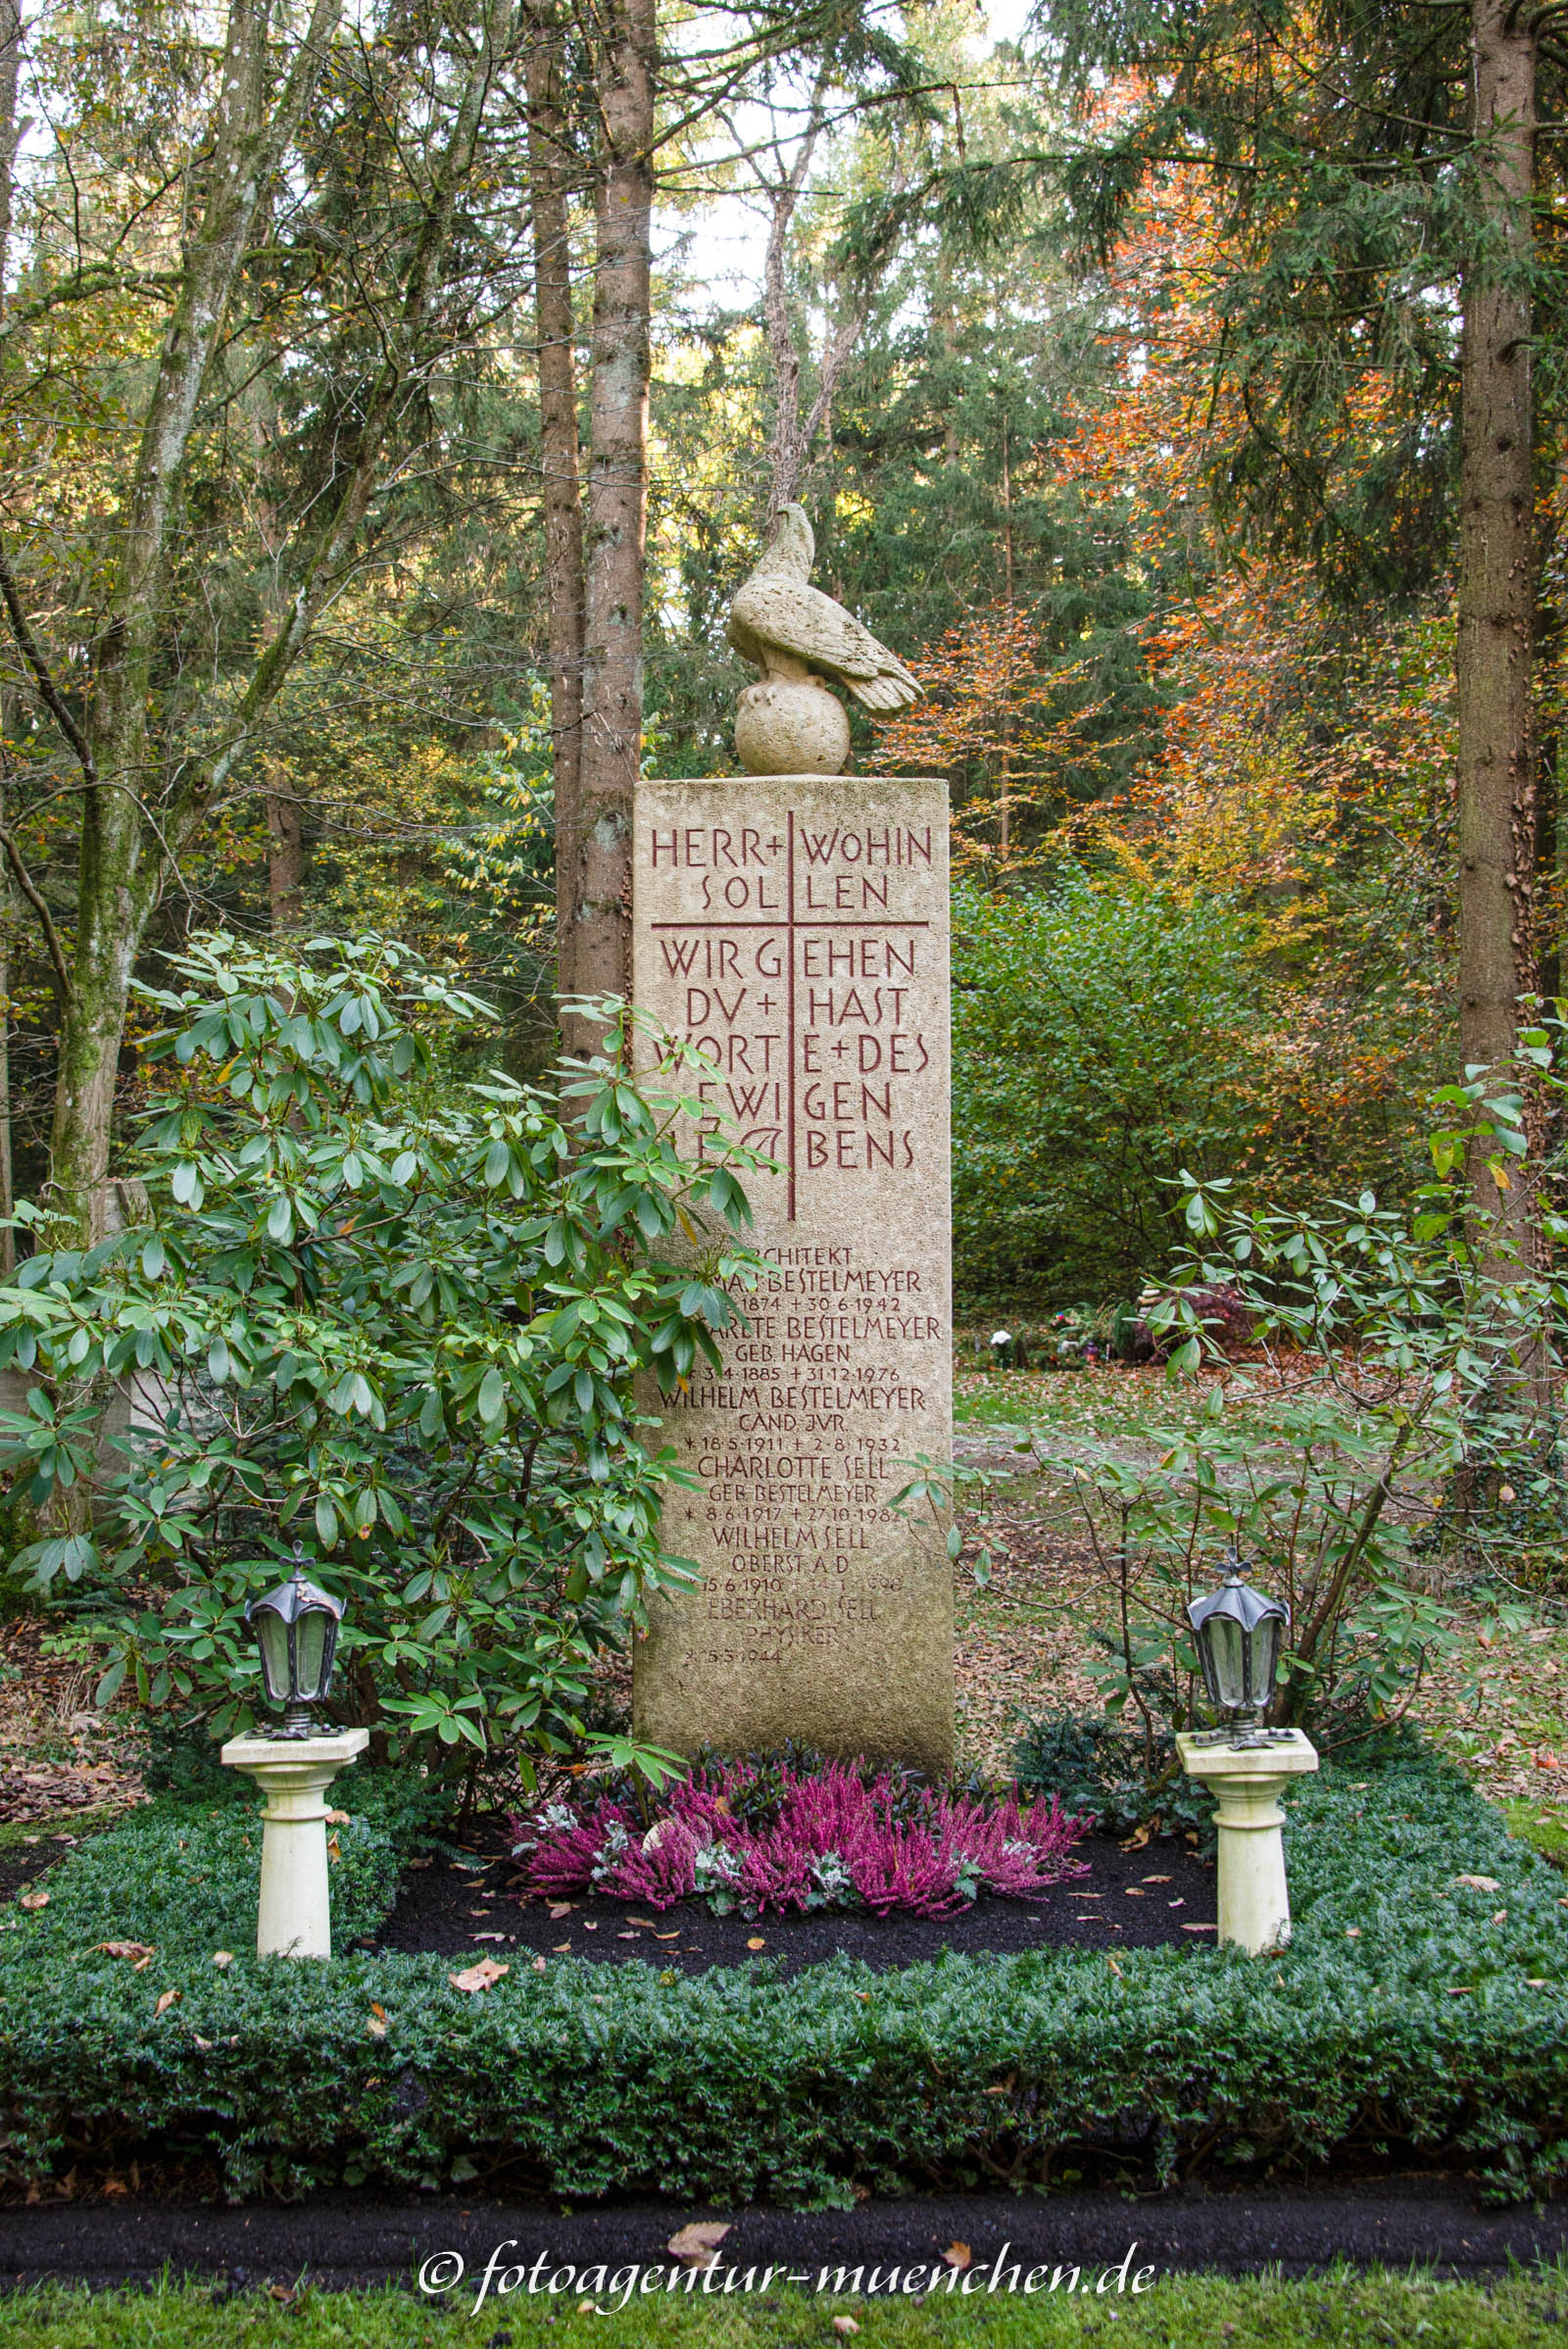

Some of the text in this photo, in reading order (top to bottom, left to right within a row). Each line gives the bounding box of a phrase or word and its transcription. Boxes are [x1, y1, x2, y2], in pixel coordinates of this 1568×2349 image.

[800, 826, 932, 865] WOHIN
[660, 939, 743, 979] WIR
[808, 987, 909, 1026] HAST
[786, 1313, 943, 1342] BESTELMEYER
[781, 1344, 851, 1363] HAGEN
[657, 1384, 927, 1411] WILHELM BESTELMEYER
[697, 1454, 890, 1480] CHARLOTTE SELL
[755, 1483, 878, 1504] BESTELMEYER
[710, 1524, 871, 1550] WILHELM SELL
[731, 1553, 803, 1575] OBERST
[708, 1593, 879, 1621] EBERHARD SELL
